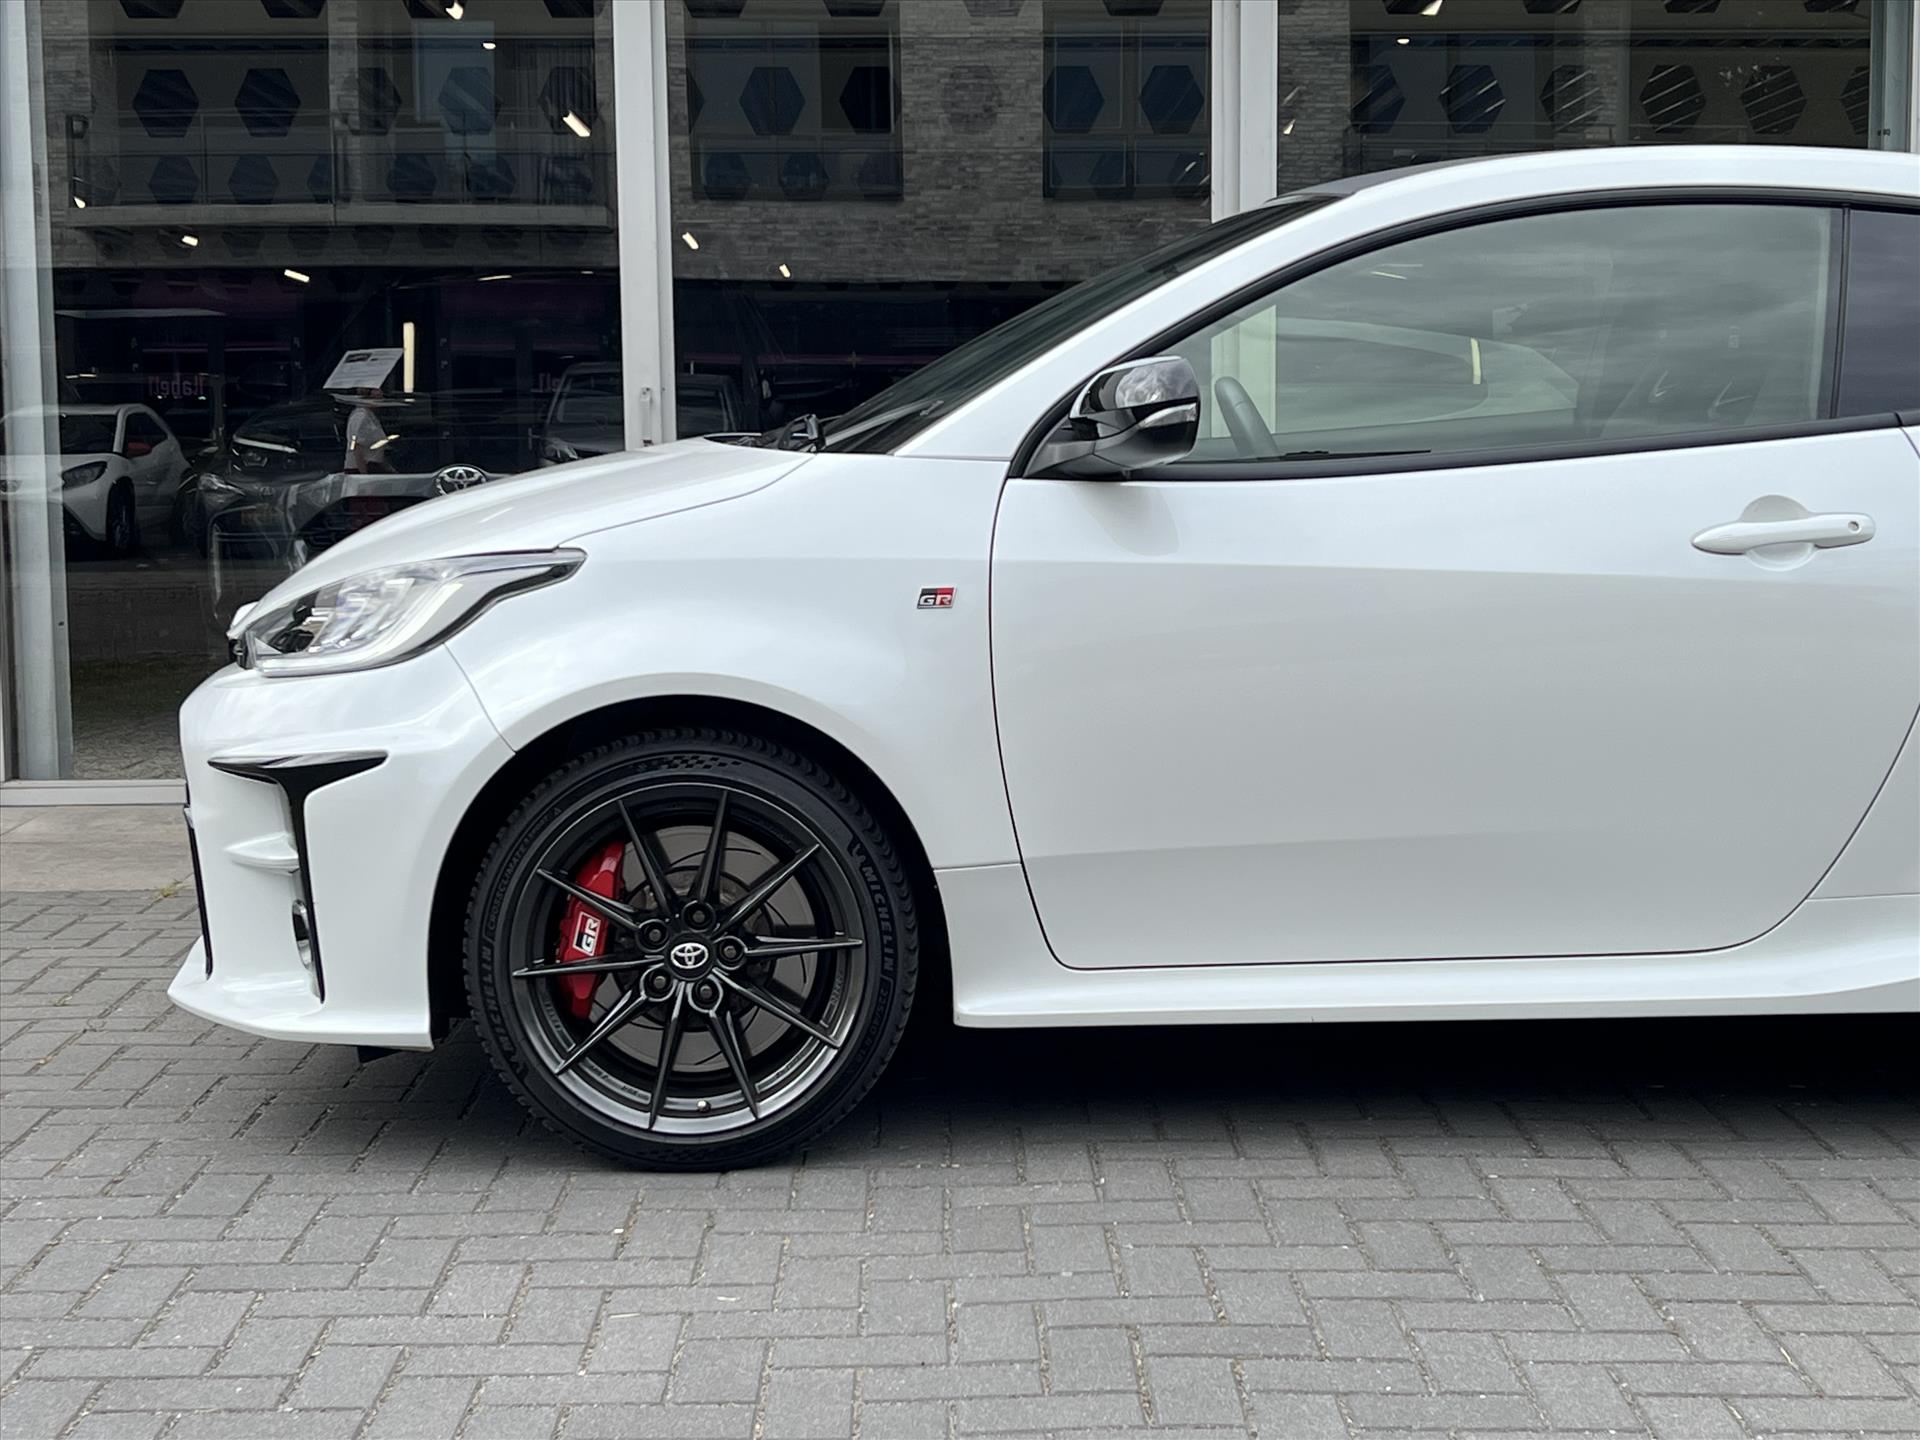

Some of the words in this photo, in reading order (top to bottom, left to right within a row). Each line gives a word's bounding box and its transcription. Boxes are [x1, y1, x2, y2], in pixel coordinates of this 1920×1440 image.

[919, 594, 952, 606] GR
[581, 917, 600, 953] GR
[861, 863, 894, 972] MICHELIN
[482, 945, 515, 1053] MICHELIN
